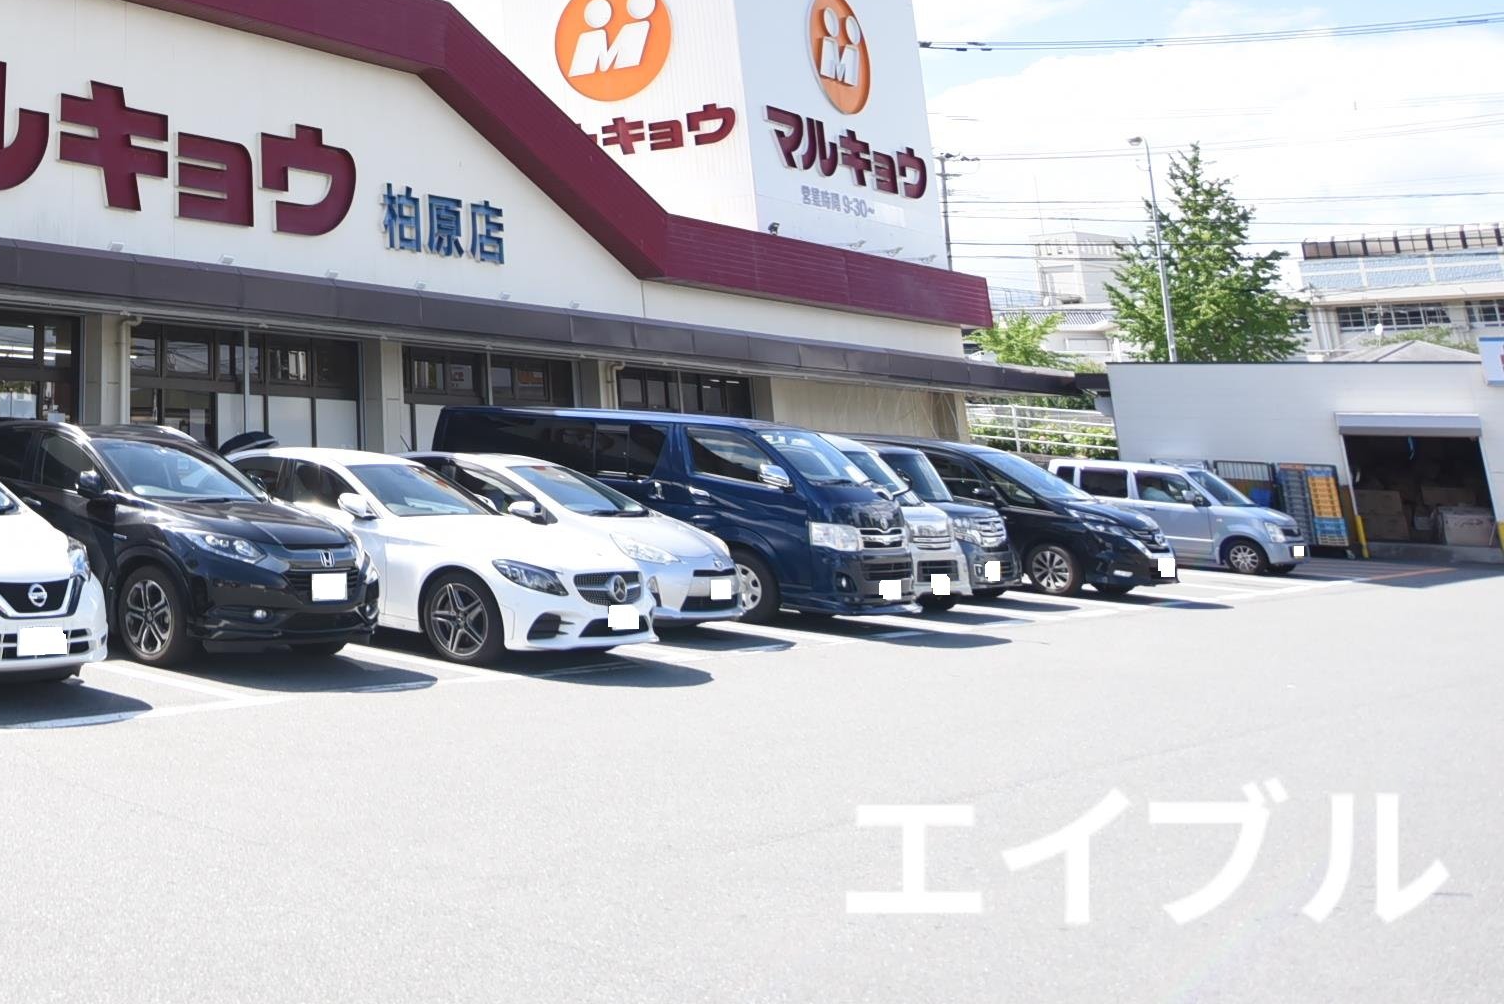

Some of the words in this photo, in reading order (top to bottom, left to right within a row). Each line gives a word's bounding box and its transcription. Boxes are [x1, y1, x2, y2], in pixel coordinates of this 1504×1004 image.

[577, 103, 736, 155] キョウ
[765, 104, 927, 200] マルキョウ
[381, 182, 505, 265] 柏原店
